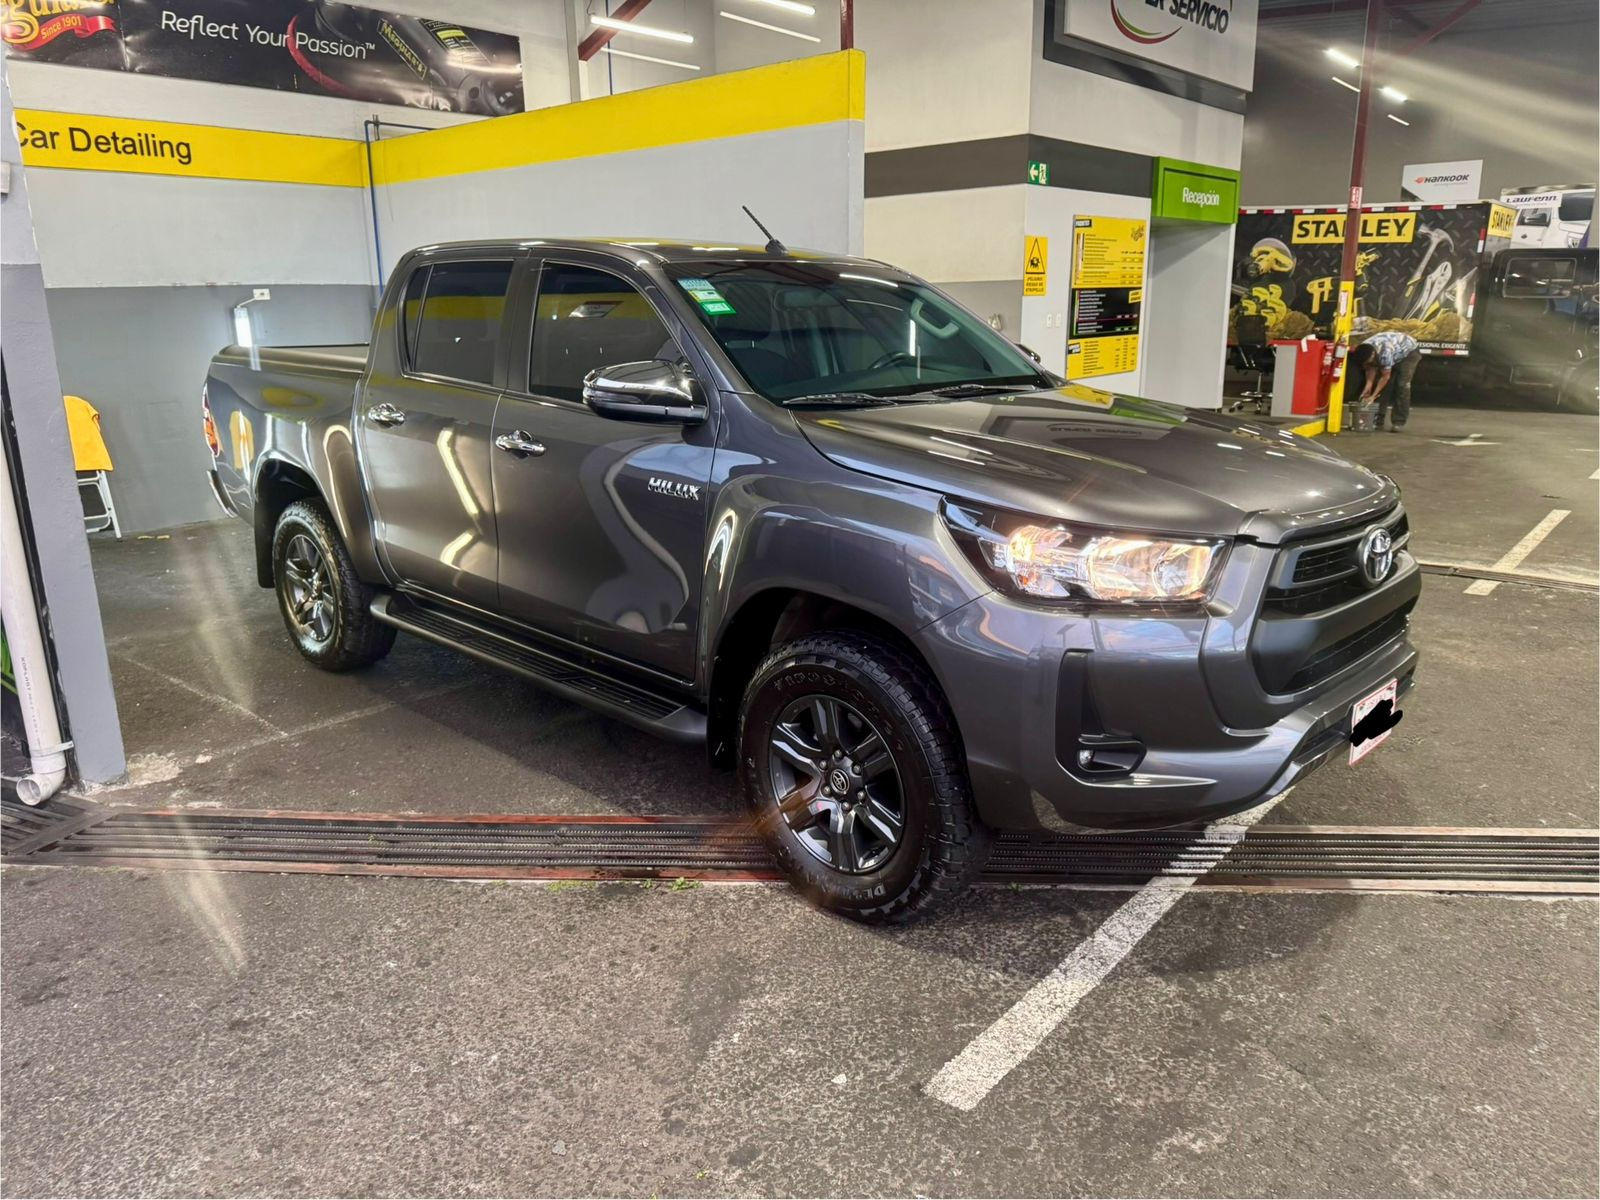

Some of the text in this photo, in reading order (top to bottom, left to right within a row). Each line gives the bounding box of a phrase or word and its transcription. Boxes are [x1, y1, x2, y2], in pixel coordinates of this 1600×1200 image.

[41, 15, 82, 39] Since 1901
[161, 10, 239, 40] Reflect
[246, 24, 291, 47] Your
[1169, 0, 1229, 34] SERVICIO
[16, 121, 192, 165] Car Detailing
[1182, 187, 1220, 208] Recepción
[1296, 219, 1410, 239] STALEY
[648, 477, 701, 500] HILUX
